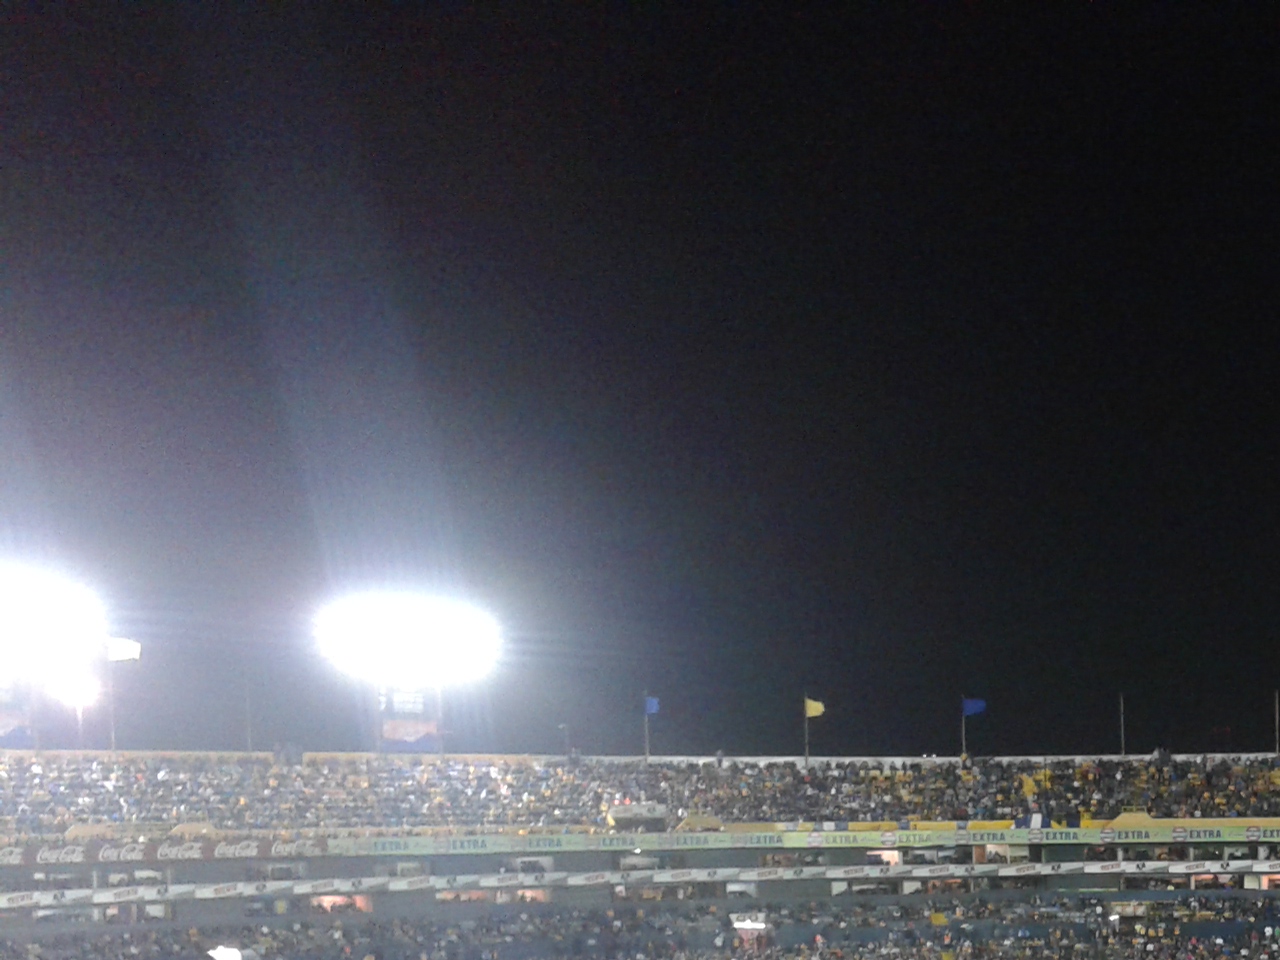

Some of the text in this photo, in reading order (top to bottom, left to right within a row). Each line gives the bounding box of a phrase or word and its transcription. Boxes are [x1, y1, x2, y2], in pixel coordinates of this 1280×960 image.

[749, 834, 783, 845] EXTRA
[825, 833, 859, 844] EXTRA
[898, 833, 933, 844] EXTRA
[972, 831, 1006, 842] EXTRA
[1045, 831, 1079, 842] EXTRA
[1117, 830, 1150, 841] EXTRA
[1189, 829, 1222, 840] EXTRA
[676, 835, 709, 846] EXTRA
